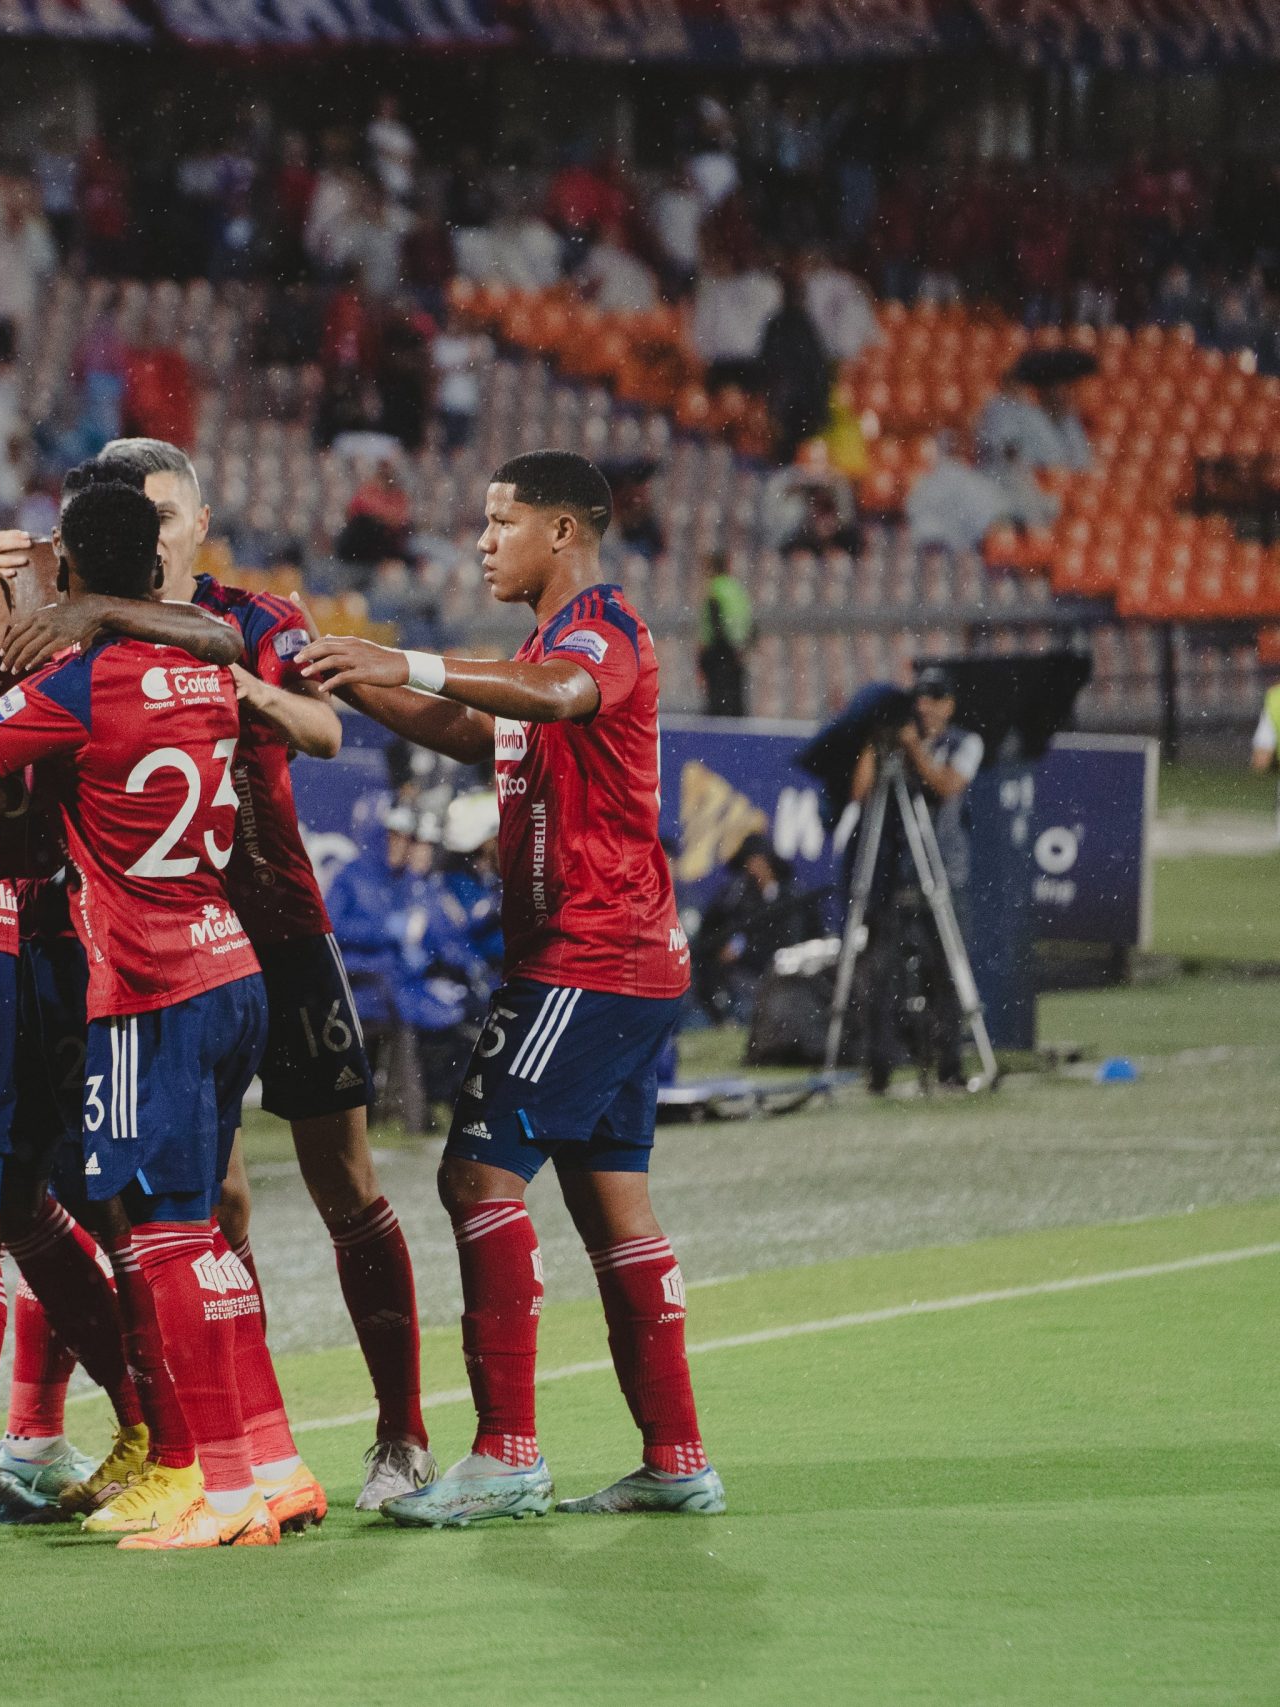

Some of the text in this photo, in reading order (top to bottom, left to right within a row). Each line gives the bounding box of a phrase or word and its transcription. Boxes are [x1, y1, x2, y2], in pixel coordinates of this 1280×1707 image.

[123, 737, 241, 878] 23
[299, 999, 353, 1058] 16
[462, 1126, 493, 1141] adidas
